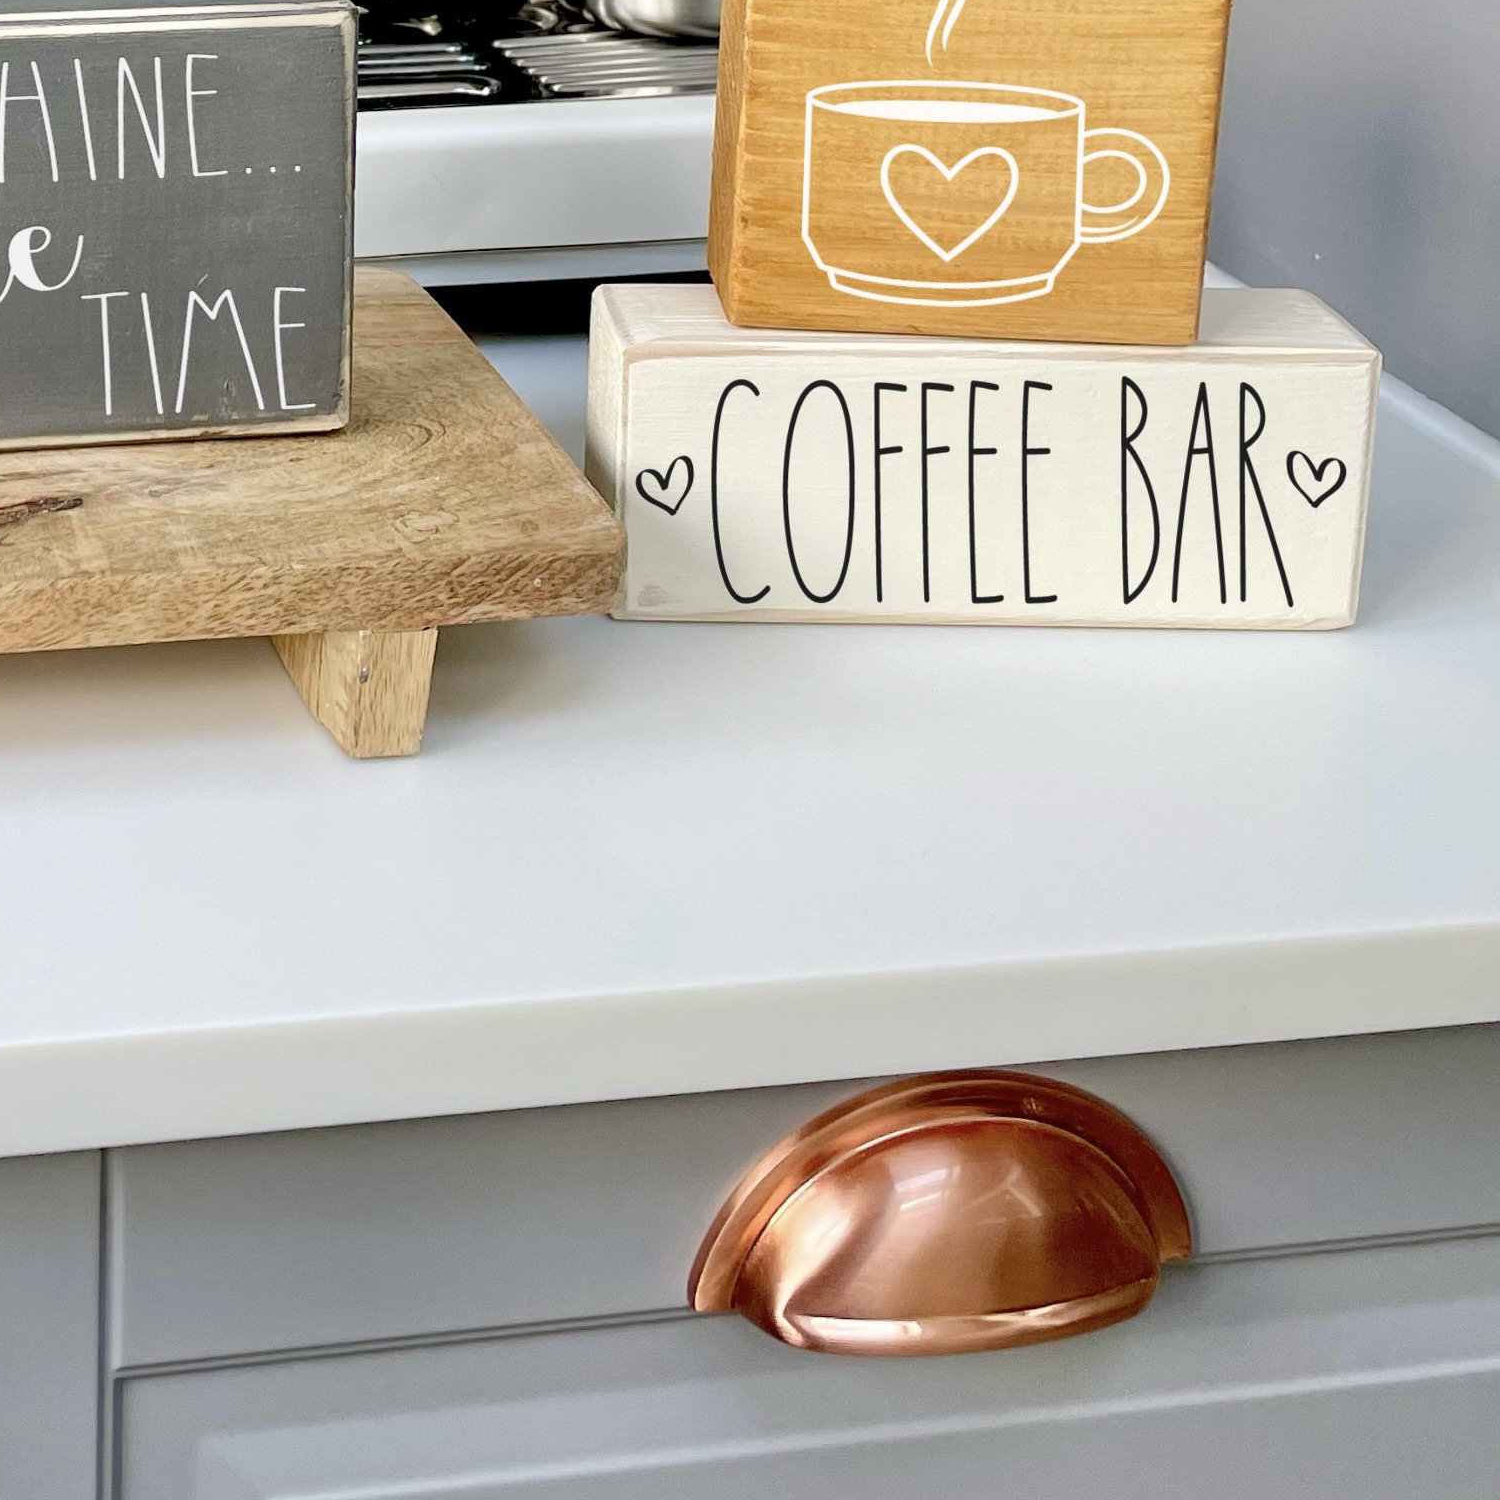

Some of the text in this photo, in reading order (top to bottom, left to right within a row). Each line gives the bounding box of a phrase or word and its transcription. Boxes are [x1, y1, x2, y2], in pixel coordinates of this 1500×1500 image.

[80, 285, 316, 417] TIME
[711, 376, 1294, 607] COFFEE BAR
